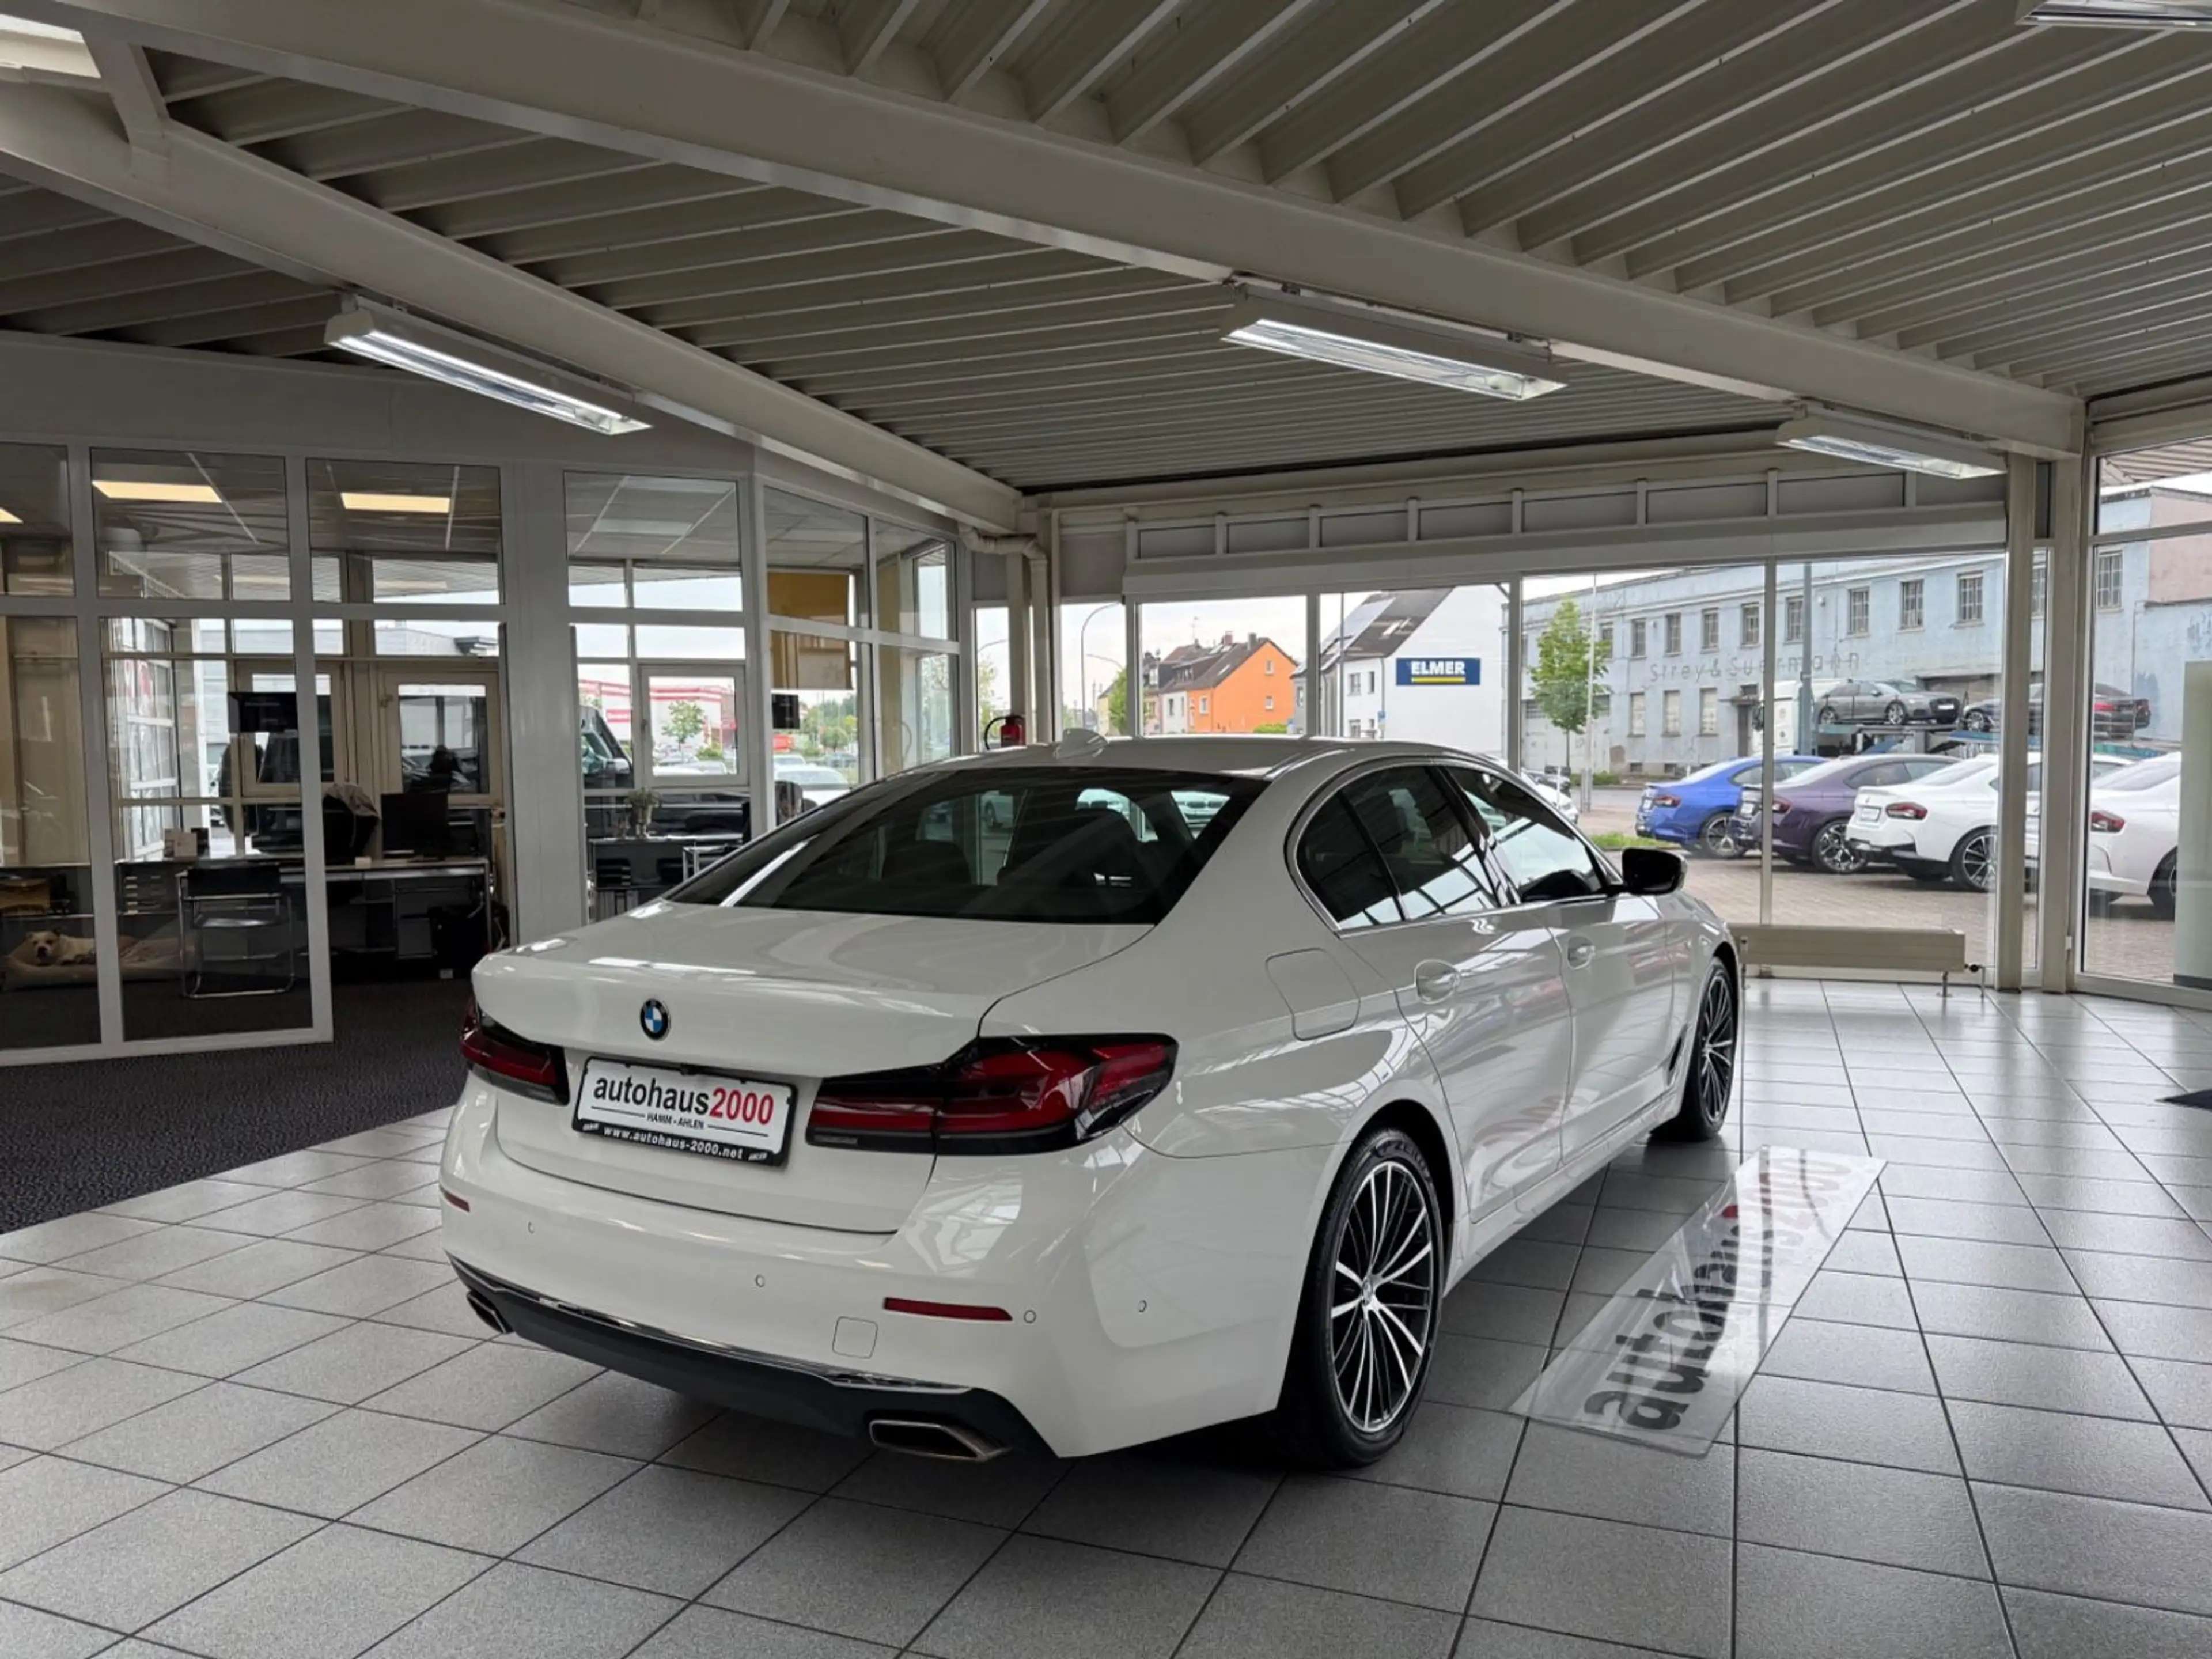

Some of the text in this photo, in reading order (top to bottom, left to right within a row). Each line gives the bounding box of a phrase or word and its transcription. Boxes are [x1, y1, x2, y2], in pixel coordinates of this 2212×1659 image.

[1411, 661, 1465, 675] ELMER
[593, 1076, 774, 1125] autohaus2000
[604, 1127, 743, 1160] www.autohaus-2000.net
